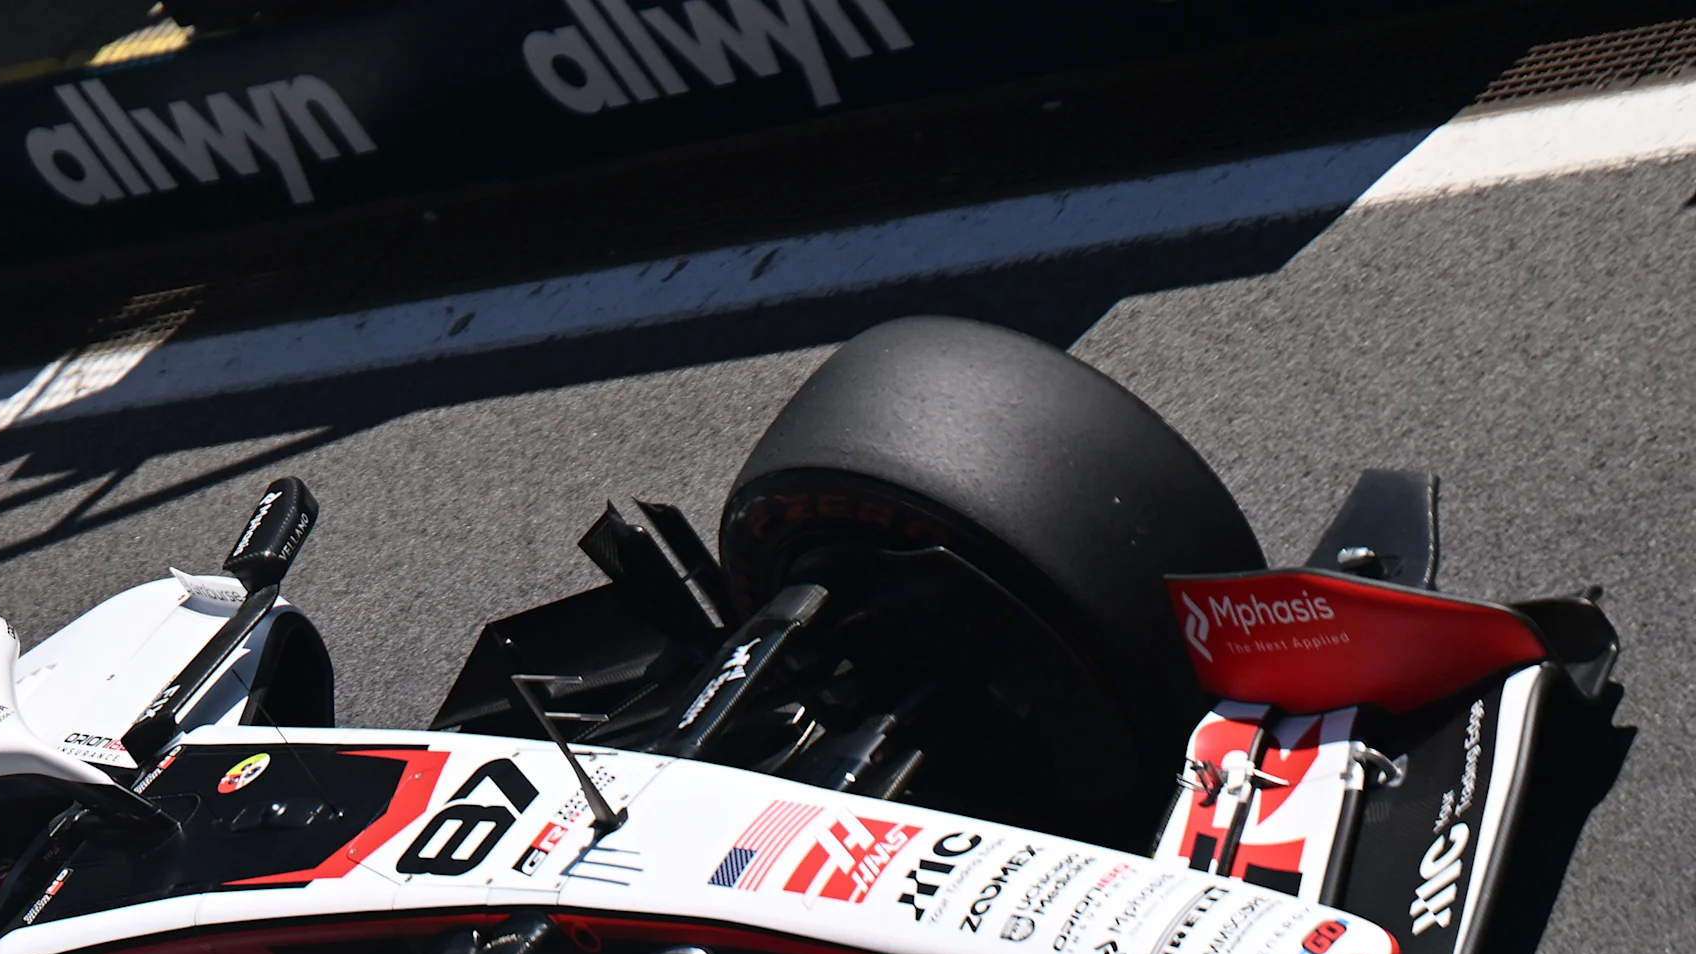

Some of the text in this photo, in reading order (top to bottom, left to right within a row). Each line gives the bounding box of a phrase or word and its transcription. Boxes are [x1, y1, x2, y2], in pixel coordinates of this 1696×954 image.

[522, 0, 913, 114] allwyn
[24, 73, 376, 204] allwyn
[278, 512, 311, 562] VELLAMO
[1209, 589, 1336, 633] Mphasis
[1225, 631, 1351, 655] The Next Applied
[396, 757, 540, 877] 87
[851, 823, 911, 893] HAAS
[959, 844, 1046, 934] ZOOMEX
